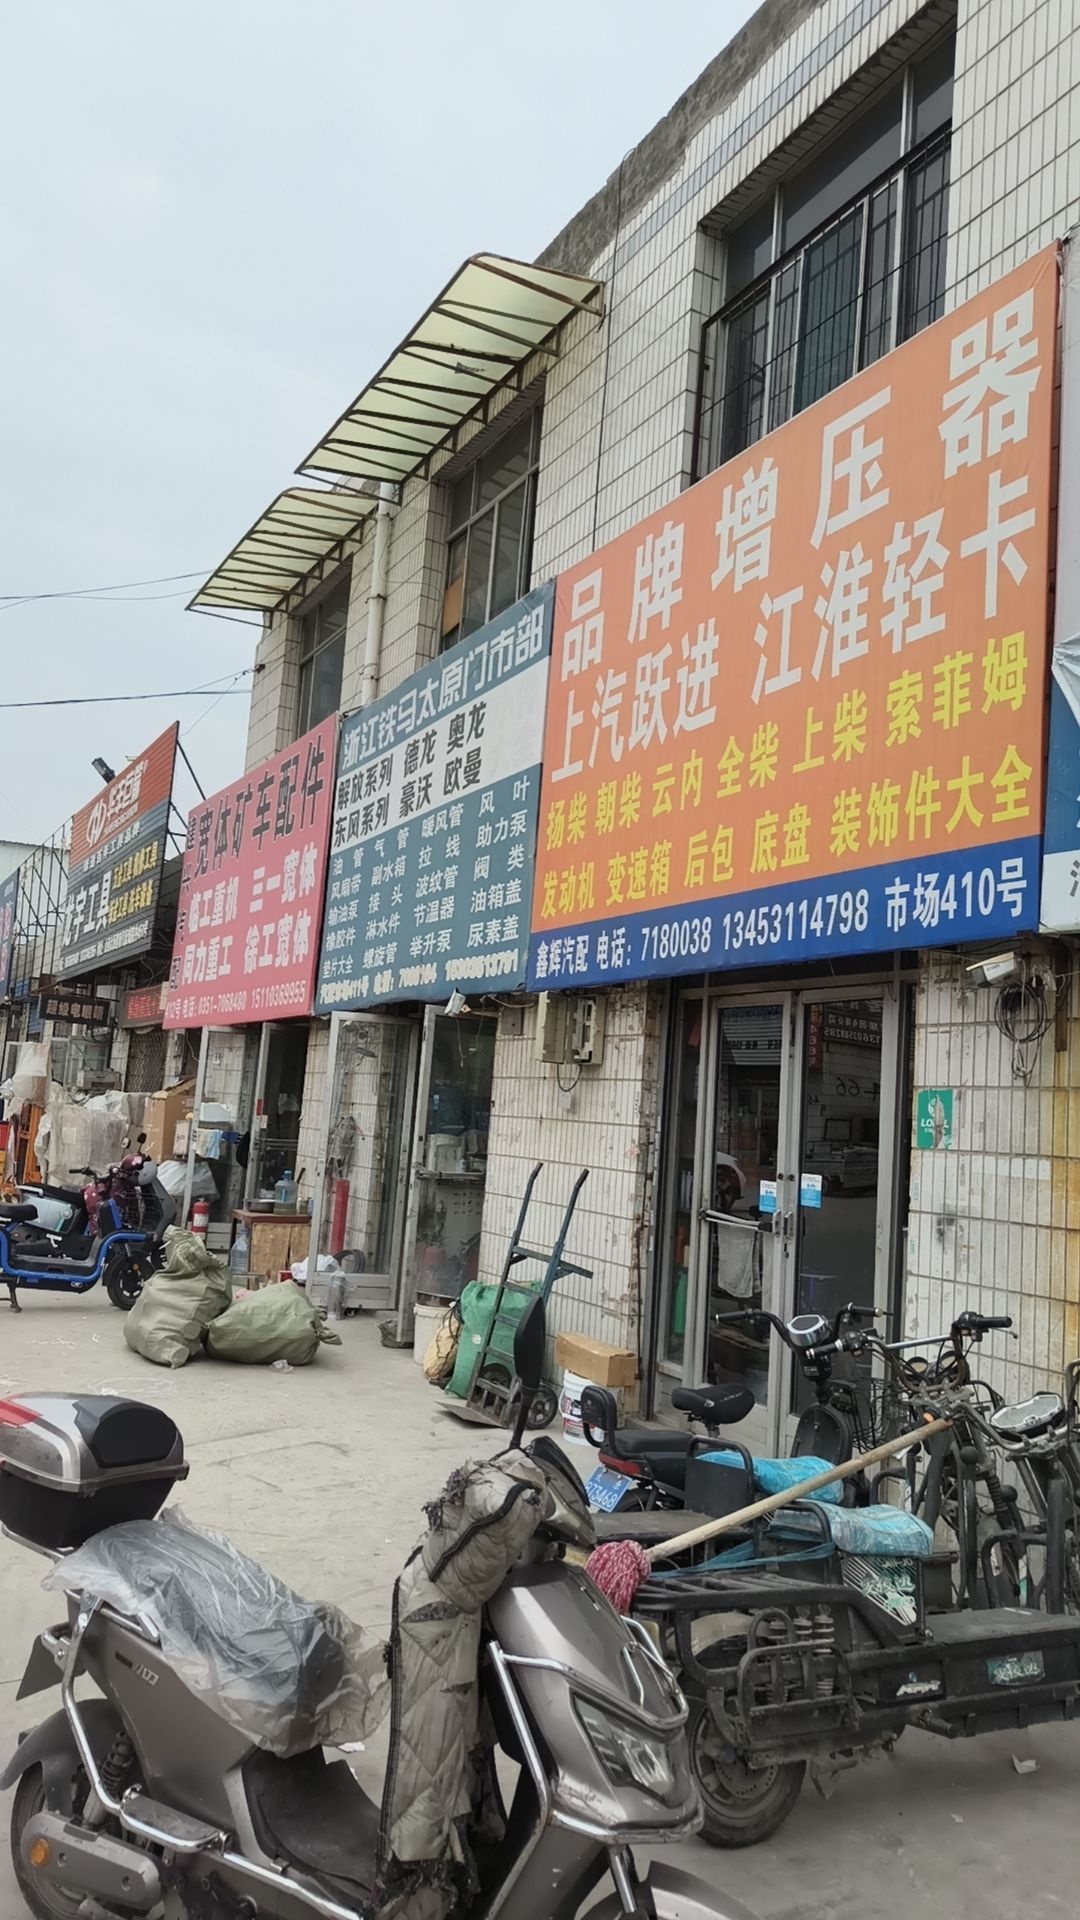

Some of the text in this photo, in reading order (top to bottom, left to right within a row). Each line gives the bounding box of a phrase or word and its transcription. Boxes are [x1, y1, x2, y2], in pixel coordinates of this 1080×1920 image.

[560, 290, 1042, 680] 品牌增压器
[551, 470, 1036, 783] 上汽跃进 江淮轻卡
[342, 603, 545, 769] 浙江铁马太原门市部
[336, 700, 487, 812] 解放系列 德龙 奥龙
[546, 631, 1028, 851] 扬柴 朝柴 云内 全柴 上柴 索菲姆
[194, 735, 325, 880] 宽体矿车配件
[333, 746, 482, 848] 东风系列 豪沃 欧曼
[421, 802, 464, 839] 暖风管
[541, 746, 1034, 919] 发动机 变速箱 后包 底盘 装饰件大全
[189, 841, 317, 934] 临工重机 三一宽体
[328, 900, 359, 927] 输油泵
[415, 865, 458, 898] 波纹管
[330, 874, 361, 901] 风扇带
[371, 855, 407, 887] 副水箱
[475, 810, 528, 848] 助力泵
[413, 897, 455, 927] 节温器
[470, 878, 522, 913] 油箱盖
[182, 934, 233, 986] 同力重工
[243, 908, 311, 974] 徐工宽体
[323, 914, 520, 979] 垫片大全 螺旋管 举升泵 尿素盖
[535, 931, 589, 979] 鑫辉汽配
[640, 917, 712, 959] 7180038
[722, 888, 869, 951] 13453114798
[884, 857, 1028, 933] 市场410号
[921, 1118, 949, 1129] LOL
